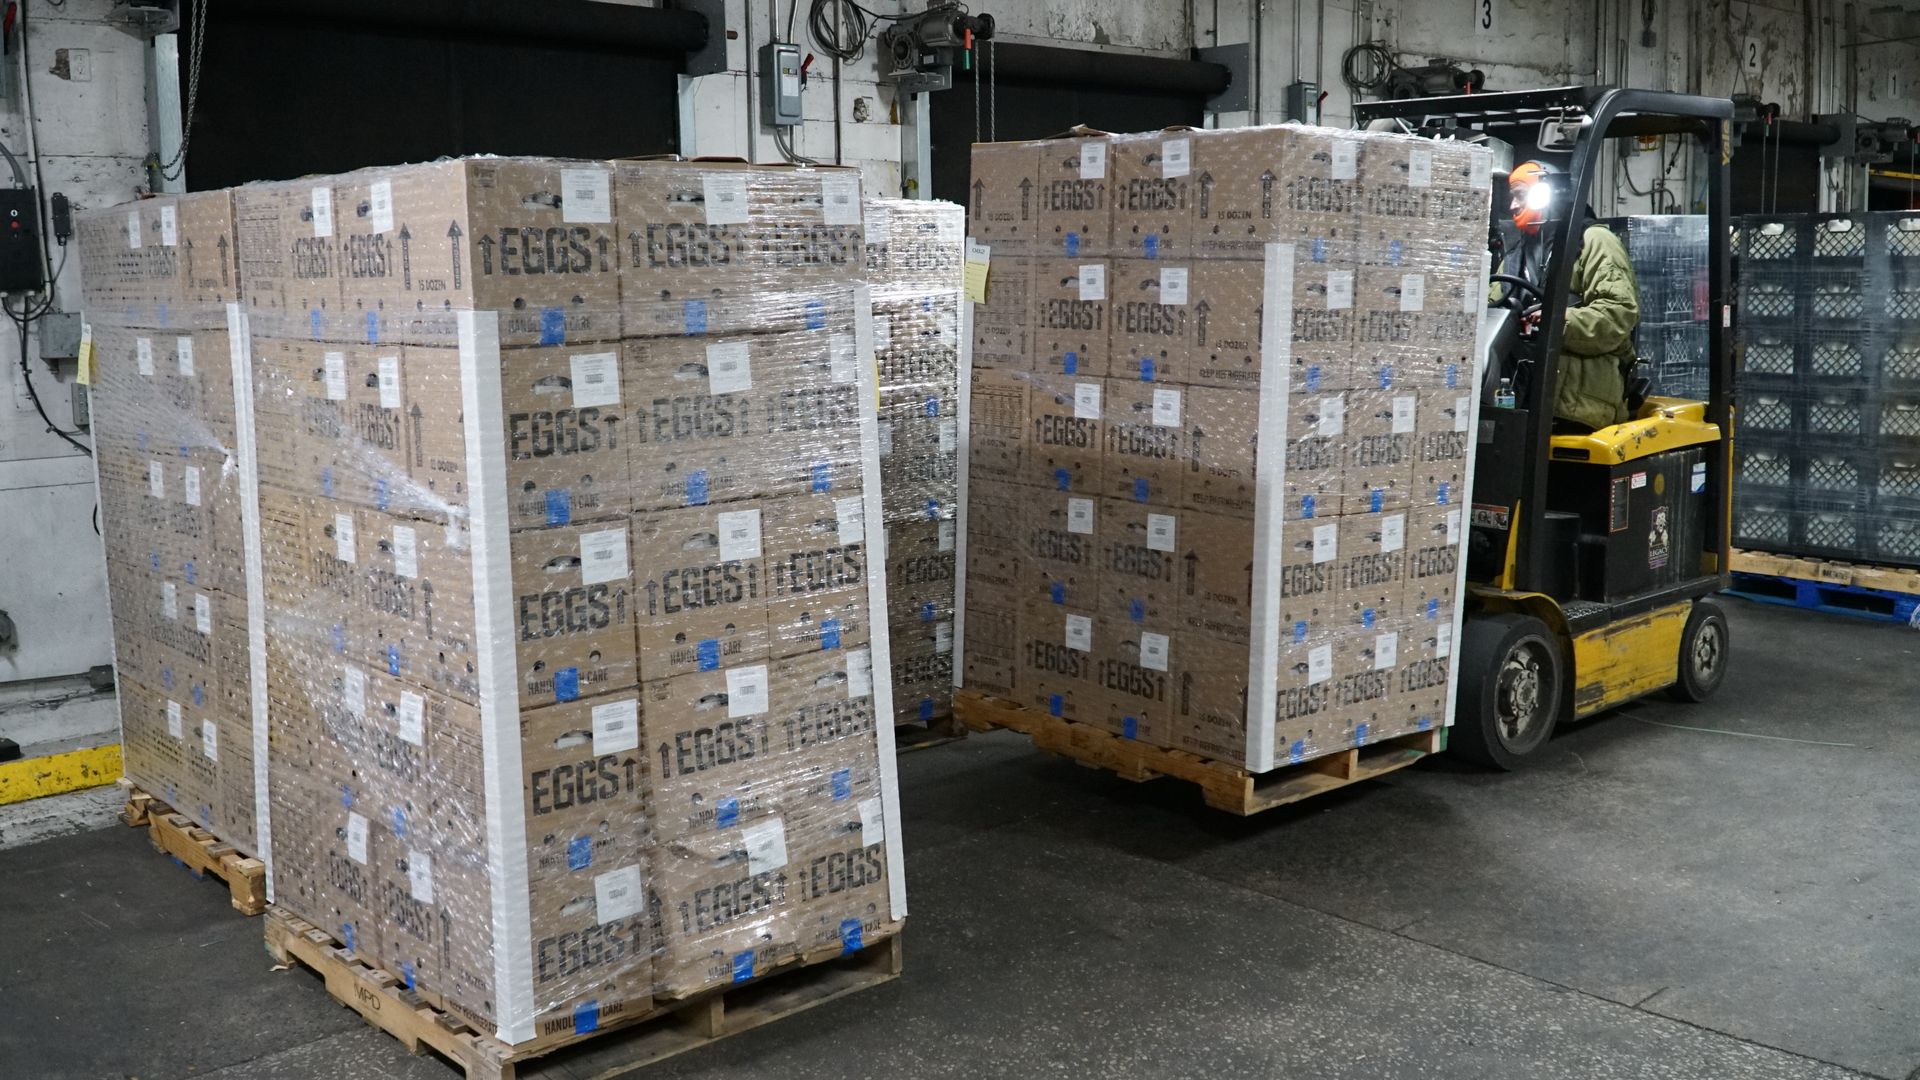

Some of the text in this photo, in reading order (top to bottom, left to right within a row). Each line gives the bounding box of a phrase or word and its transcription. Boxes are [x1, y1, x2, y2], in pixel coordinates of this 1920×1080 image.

[1482, 0, 1492, 29] 3
[1750, 43, 1757, 67] 2
[1892, 74, 1897, 95] 1
[1051, 180, 1095, 211] EGGS
[1129, 177, 1177, 211] EGGS
[351, 233, 386, 278] EGGS
[500, 227, 593, 276] EGGS
[647, 223, 730, 267] EGGS
[1050, 299, 1094, 331] EGGS
[1126, 302, 1177, 335] EGGS
[510, 407, 600, 461] EGGS
[653, 398, 738, 444] EGGS
[1044, 414, 1088, 448] EGGS
[790, 544, 861, 594] EGGS
[1351, 551, 1393, 587] EGGS
[1419, 545, 1457, 578] EGGS
[1649, 547, 1668, 558] LEGACY
[662, 561, 744, 614] EGGS
[1281, 561, 1324, 599] EGGS
[520, 584, 611, 642] EGGS
[670, 639, 743, 666] HANDL CARE
[1035, 640, 1080, 678] EGGS
[586, 667, 609, 684] CARE
[1107, 658, 1156, 699] EGGS
[1276, 683, 1322, 723] EGGS
[675, 718, 759, 776] EGGS
[532, 755, 620, 817] EGGS
[811, 843, 883, 899] EGGS
[695, 872, 776, 934] EGGS
[538, 922, 625, 985] EGGS
[353, 983, 381, 1011] MPD
[603, 1000, 624, 1017] CARE
